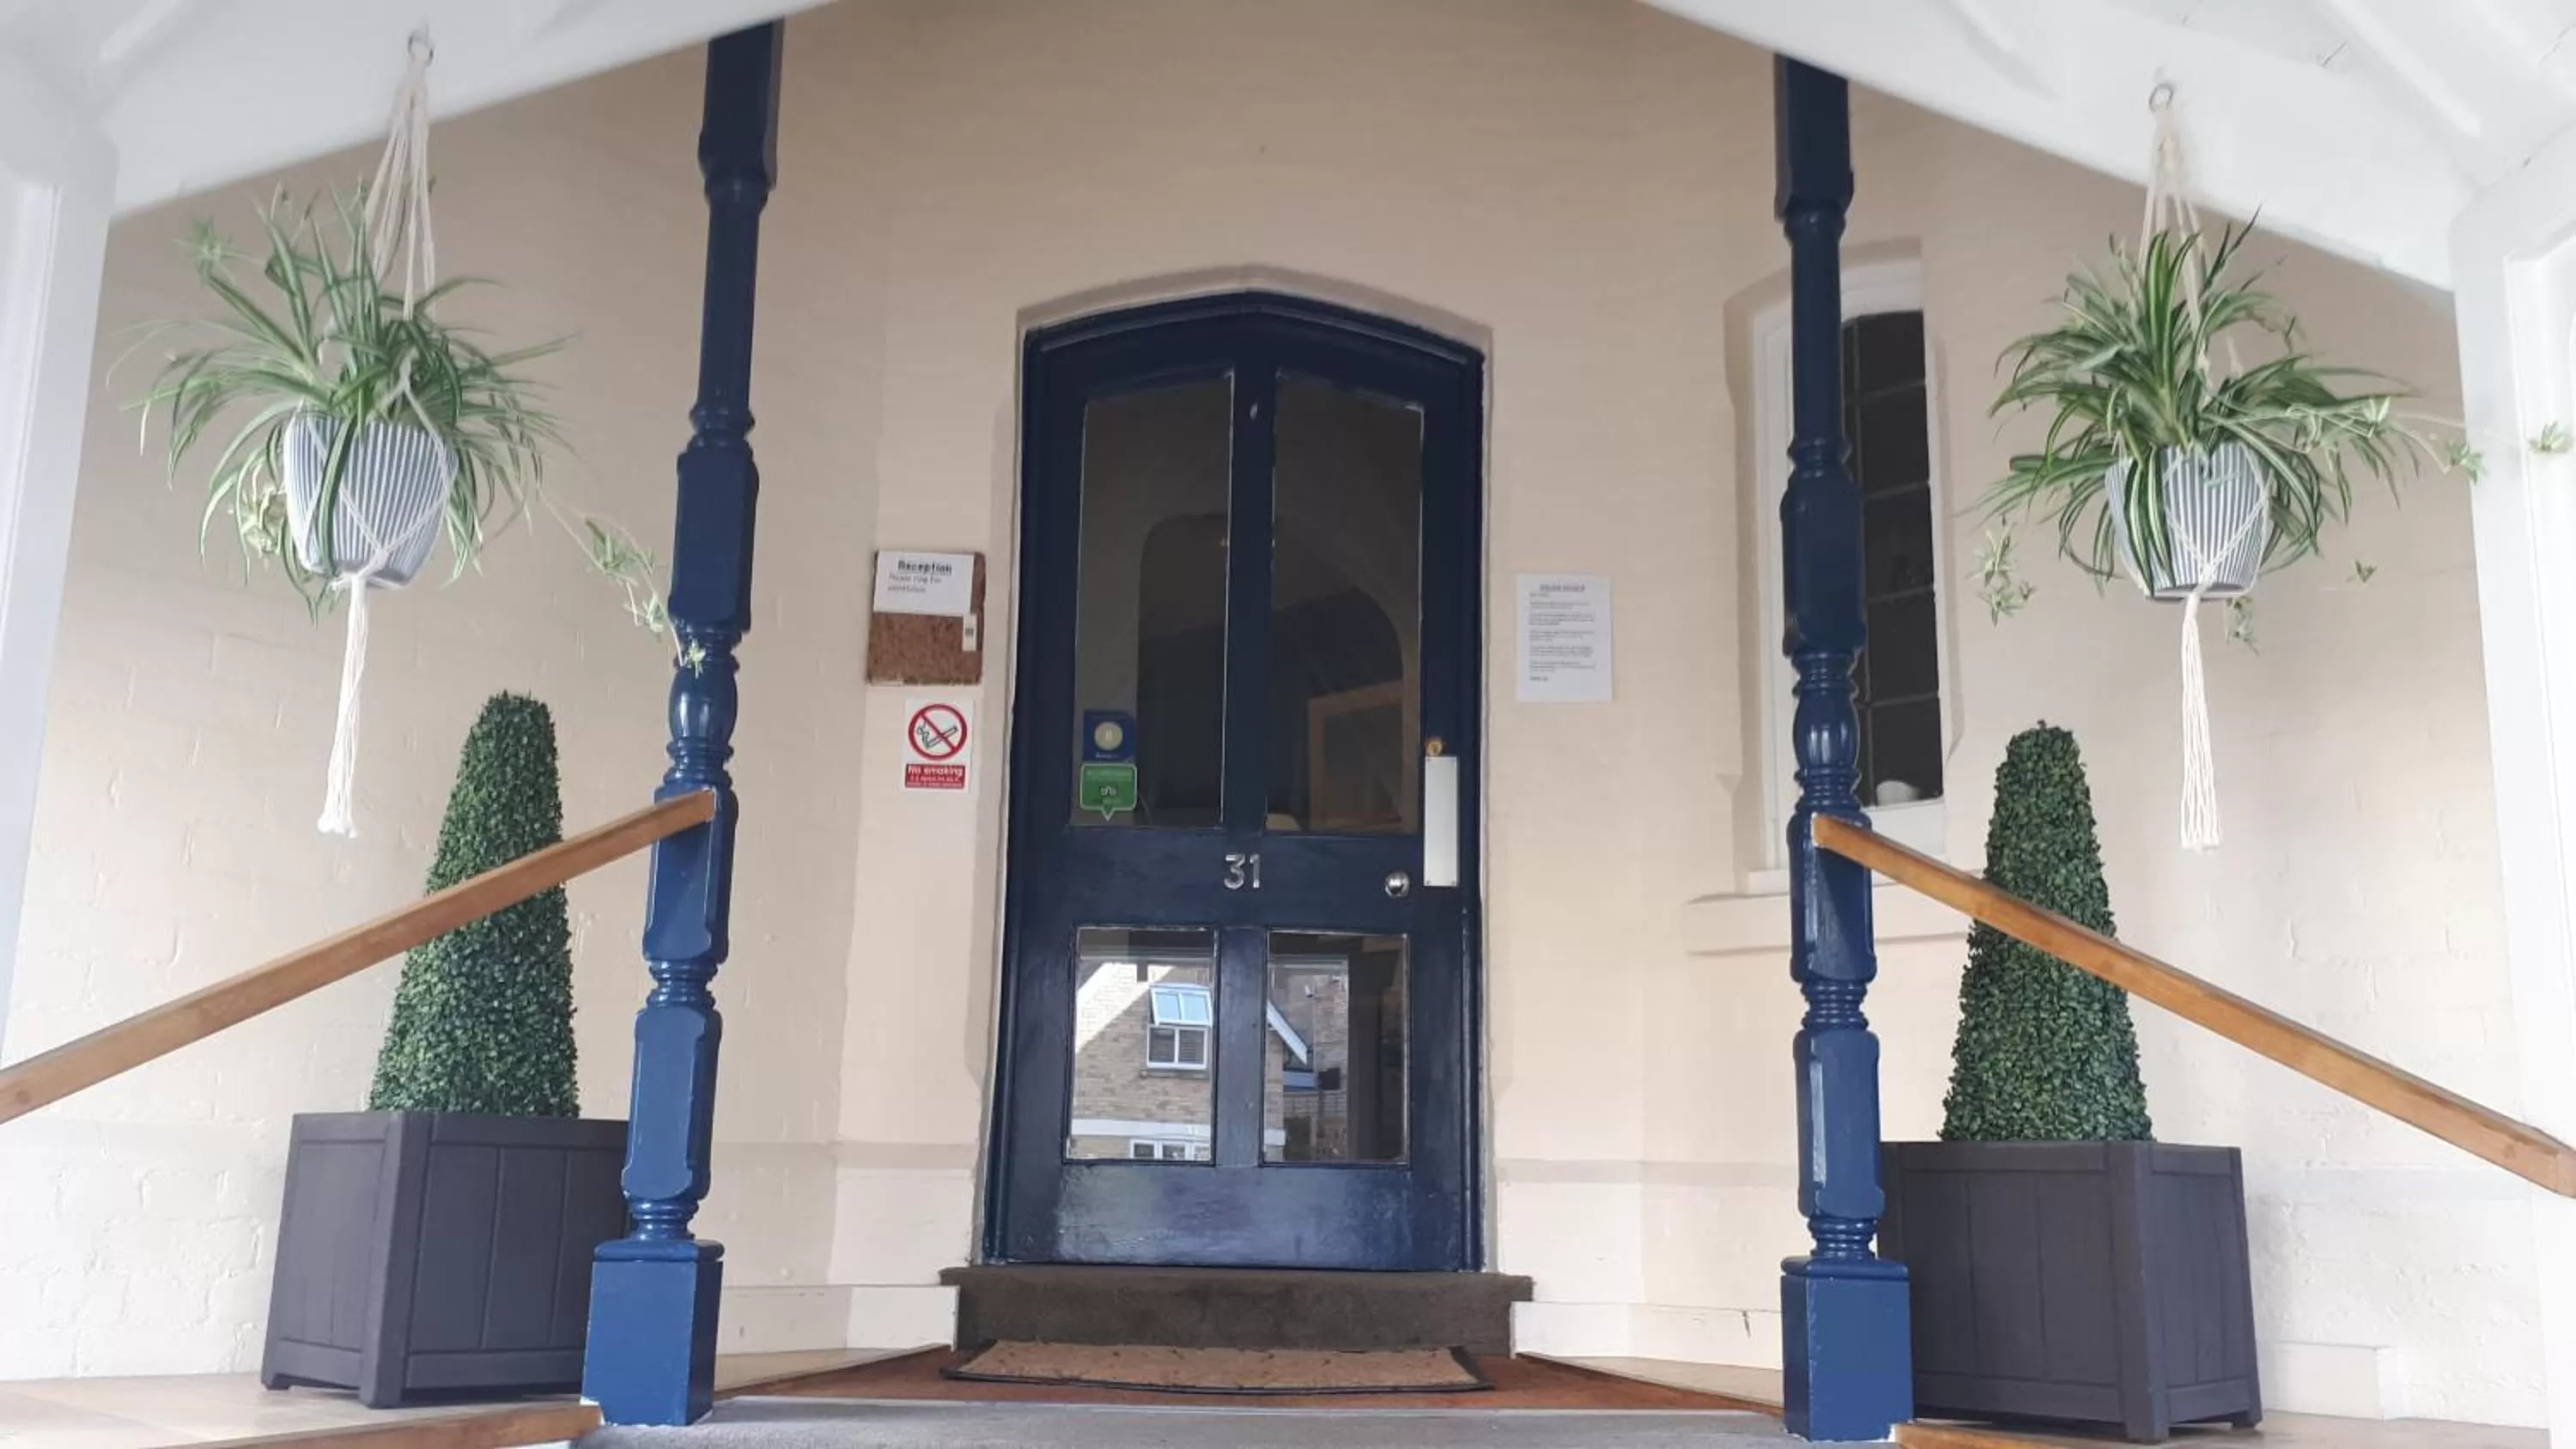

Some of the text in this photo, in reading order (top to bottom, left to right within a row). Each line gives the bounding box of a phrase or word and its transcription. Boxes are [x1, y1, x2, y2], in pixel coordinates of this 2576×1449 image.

[897, 561, 952, 575] Reception
[923, 765, 963, 777] smoking
[1224, 853, 1261, 889] 31
